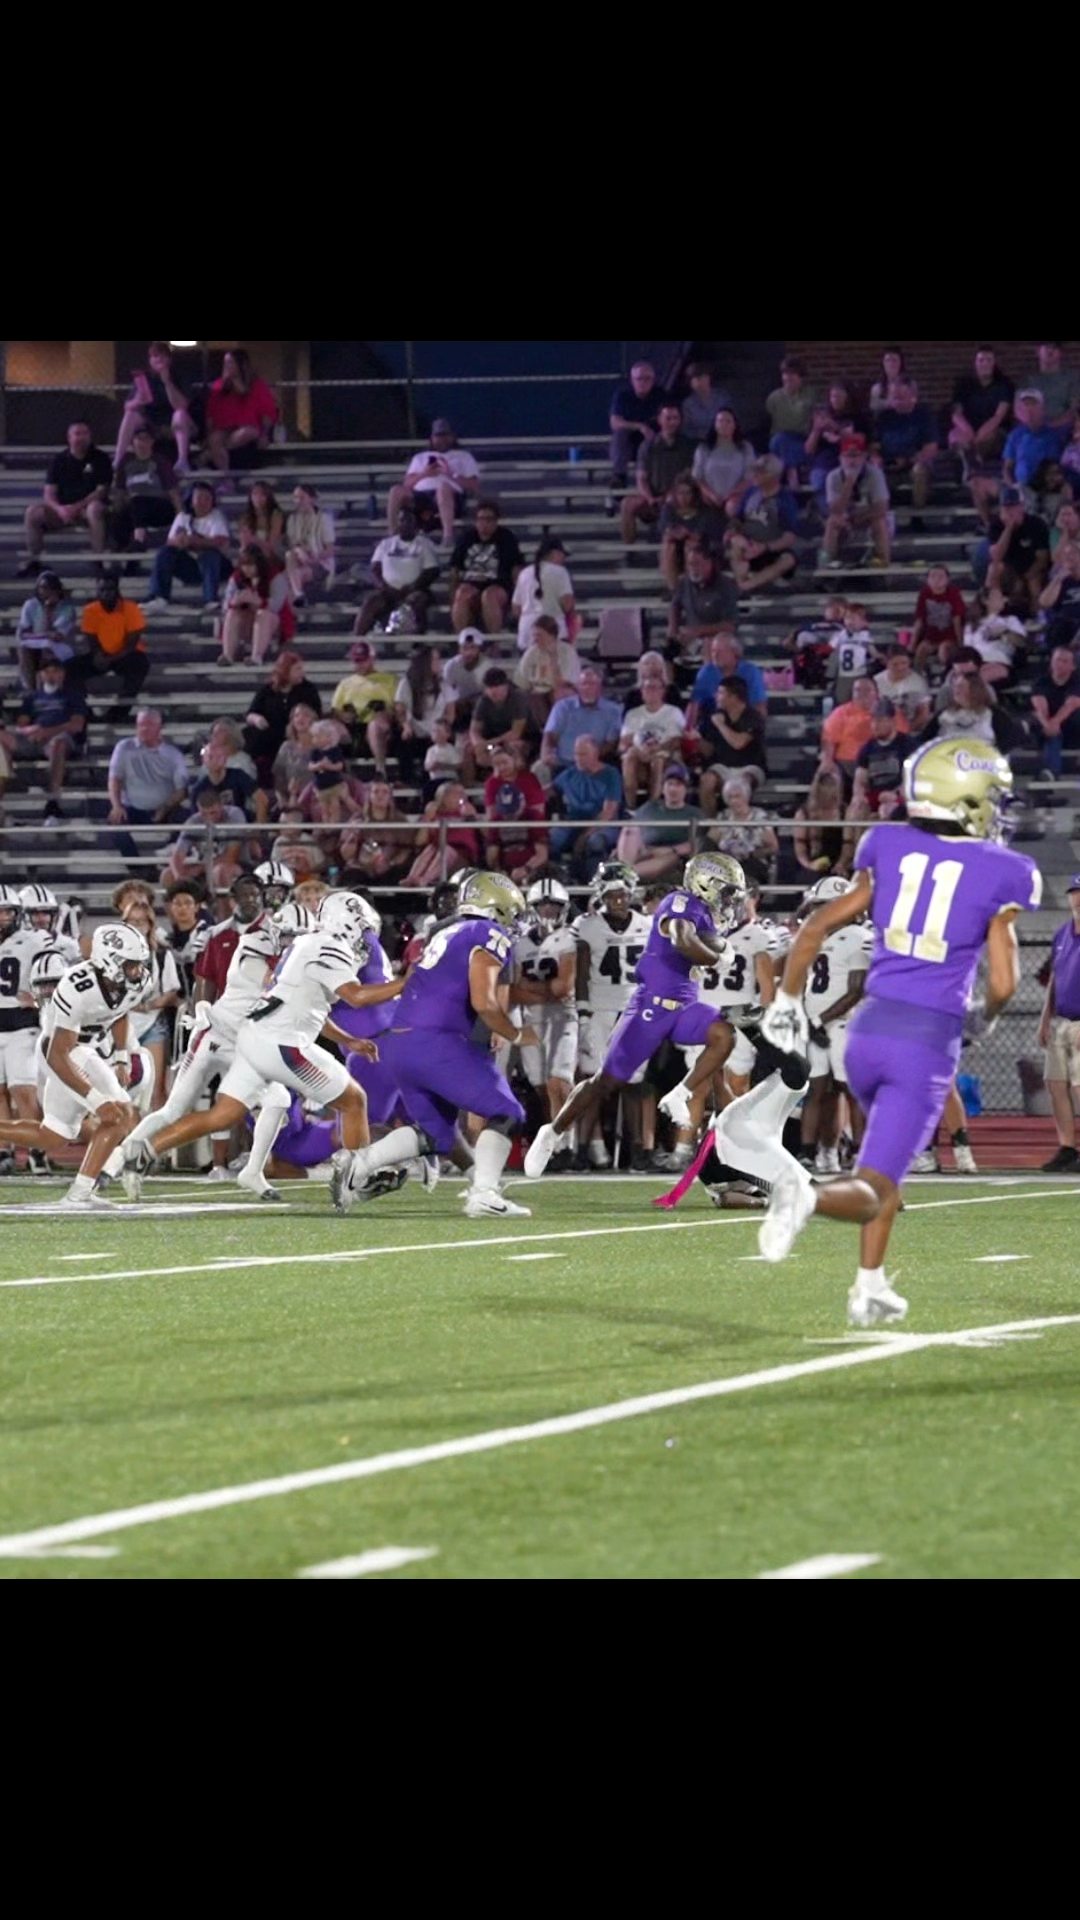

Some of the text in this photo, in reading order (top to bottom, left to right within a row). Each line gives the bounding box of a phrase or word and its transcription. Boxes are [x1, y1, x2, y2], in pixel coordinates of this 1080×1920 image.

[842, 650, 854, 672] 8
[956, 749, 1001, 773] Can
[884, 852, 964, 963] 11
[600, 945, 645, 985] 45
[703, 954, 747, 991] 33
[68, 969, 95, 993] 28
[642, 1008, 653, 1022] C
